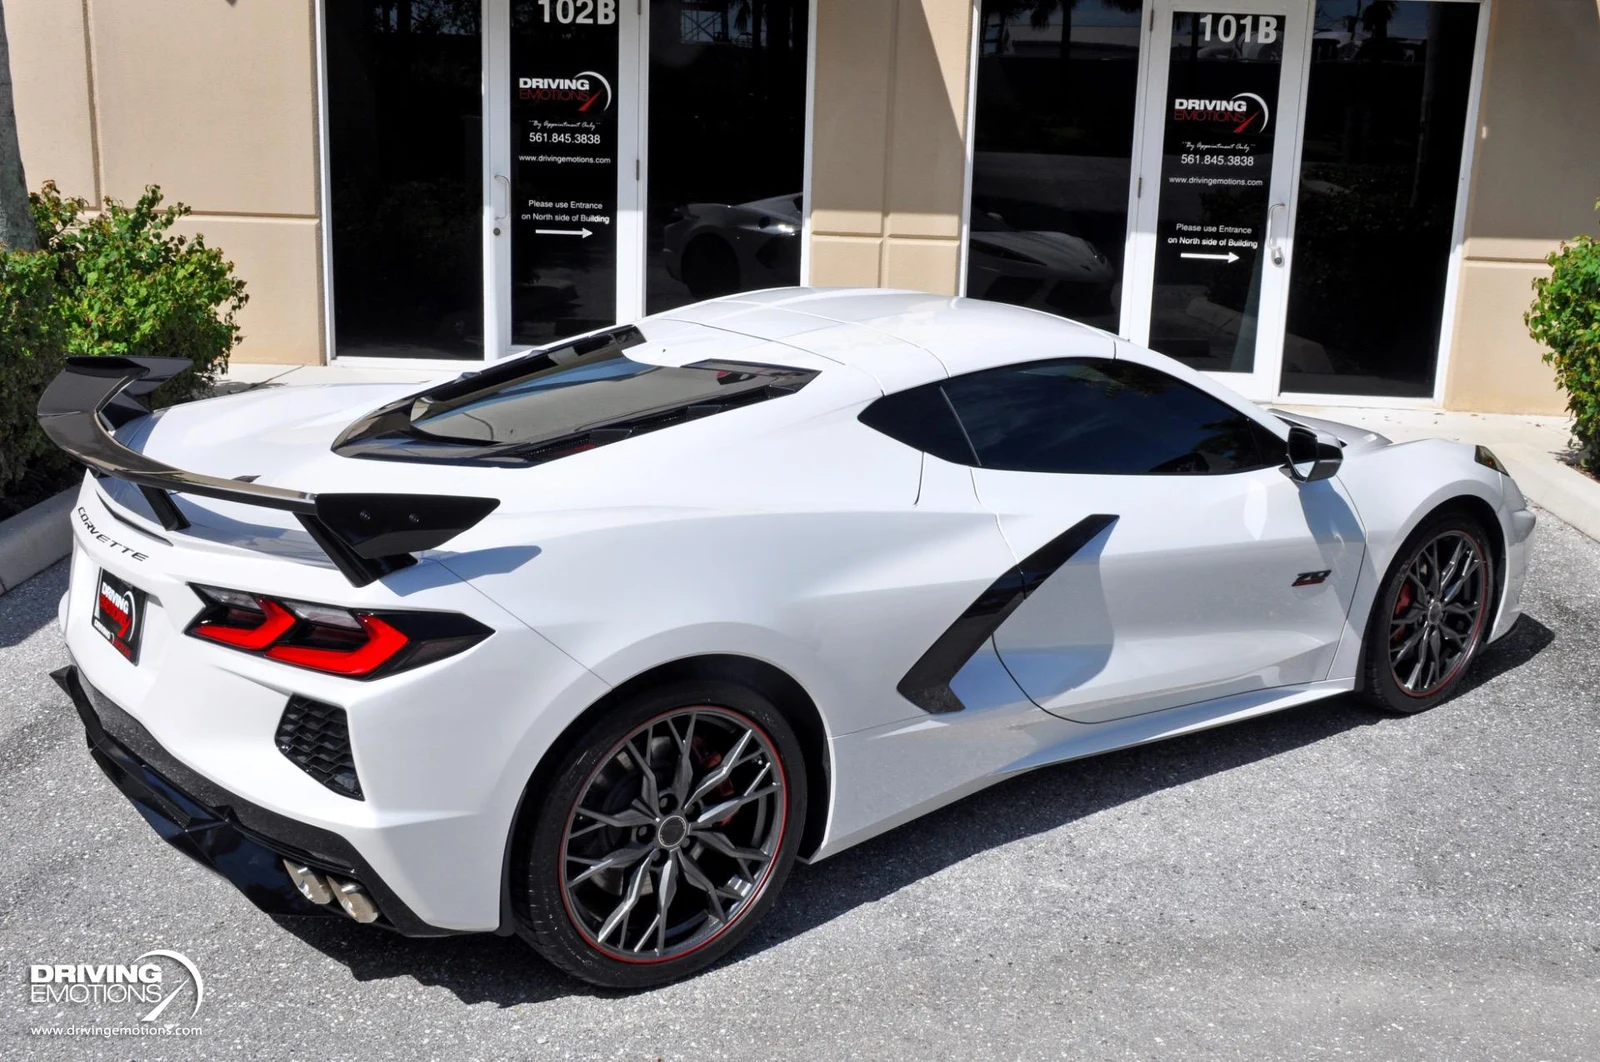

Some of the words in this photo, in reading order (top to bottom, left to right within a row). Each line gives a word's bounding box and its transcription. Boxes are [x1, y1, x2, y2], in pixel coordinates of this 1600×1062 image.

[538, 0, 616, 25] 102B
[1200, 13, 1278, 44] 101B
[519, 77, 590, 91] DRIVING
[519, 89, 590, 101] EMOTIONS
[1174, 99, 1247, 112] DRIVING
[1173, 110, 1246, 122] EMOTIONS
[543, 120, 580, 129] Appointment
[529, 132, 601, 144] 561.845.3838
[1196, 142, 1235, 151] Appointment
[518, 154, 611, 164] www.drivingemotions.com
[1181, 154, 1254, 166] 561.845.3838
[1168, 176, 1263, 186] www.drivingemotions.com
[528, 200, 554, 208] Please
[570, 201, 603, 210] Entrance
[532, 213, 553, 221] North
[554, 213, 570, 222] side
[572, 214, 579, 222] of
[580, 214, 610, 225] Building
[1176, 223, 1202, 232] Please
[1218, 225, 1252, 234] Entrance
[1179, 237, 1201, 245] North
[1201, 237, 1218, 246] side
[1219, 238, 1226, 246] of
[1228, 239, 1258, 249] Building
[77, 506, 149, 562] CORVETTE
[101, 581, 129, 615] DRIVING
